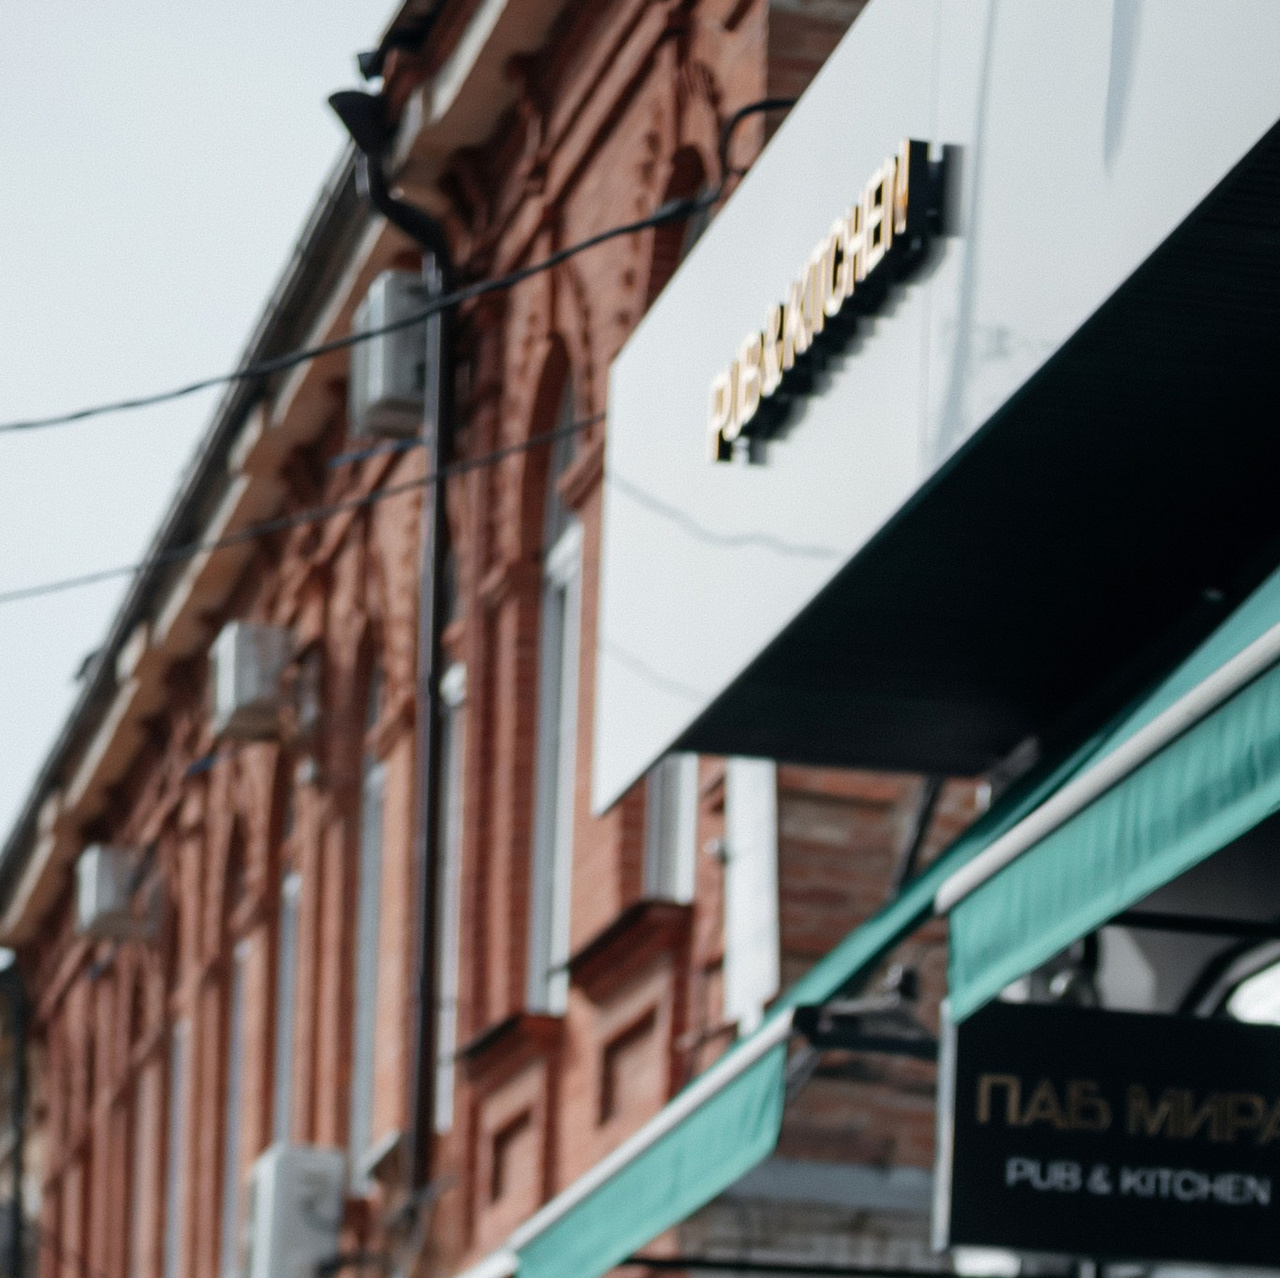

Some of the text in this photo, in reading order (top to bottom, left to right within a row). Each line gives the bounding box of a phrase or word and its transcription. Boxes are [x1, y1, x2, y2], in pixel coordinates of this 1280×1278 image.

[976, 1072, 1113, 1134] ПАБ
[1004, 1156, 1272, 1206] PUB & KITCHEN
